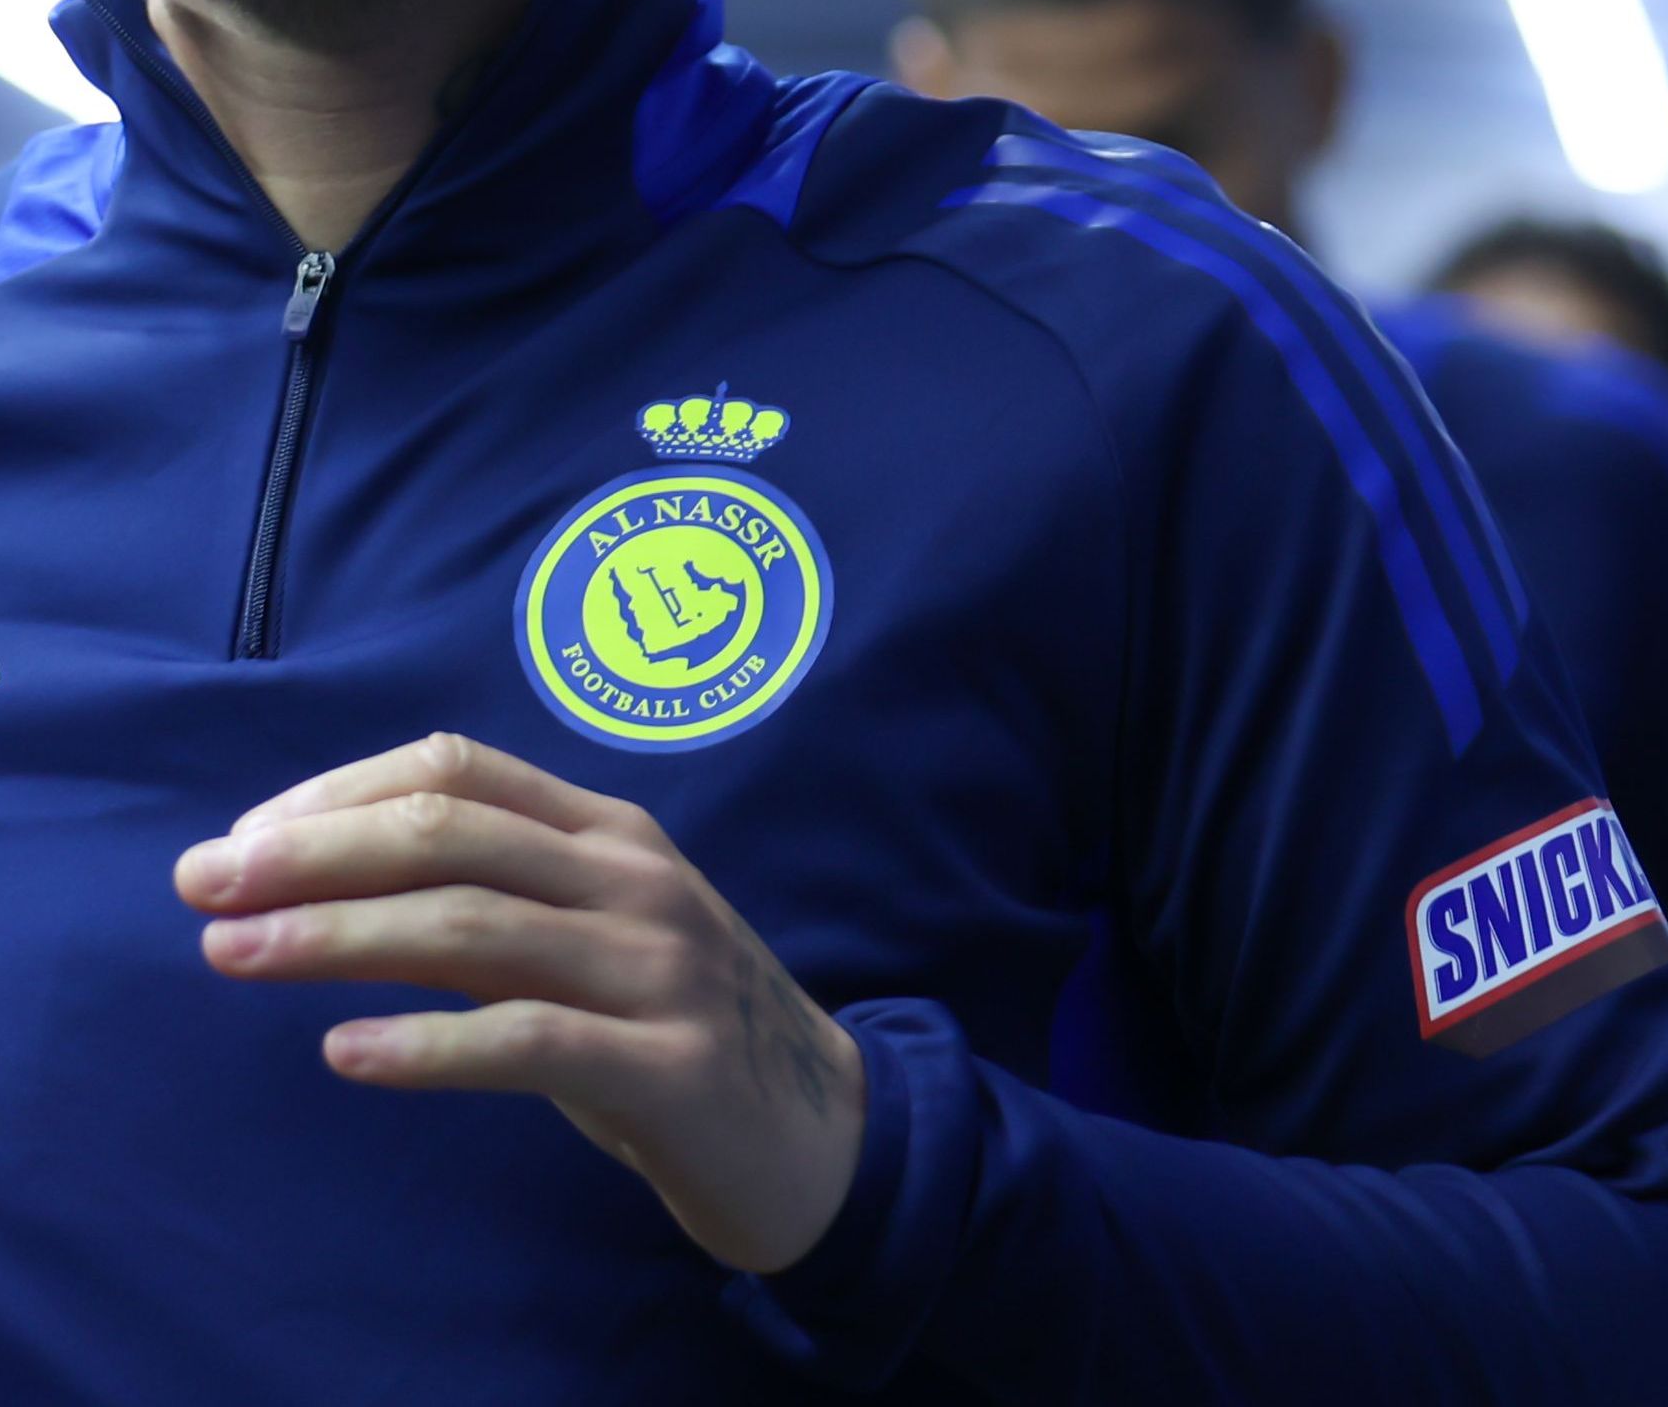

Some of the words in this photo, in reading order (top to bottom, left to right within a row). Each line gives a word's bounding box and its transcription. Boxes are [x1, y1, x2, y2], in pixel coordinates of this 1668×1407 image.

[587, 507, 645, 558] AL
[652, 496, 786, 571] NASSR
[562, 642, 690, 718] FOOTBALL
[698, 654, 767, 709] CLUB
